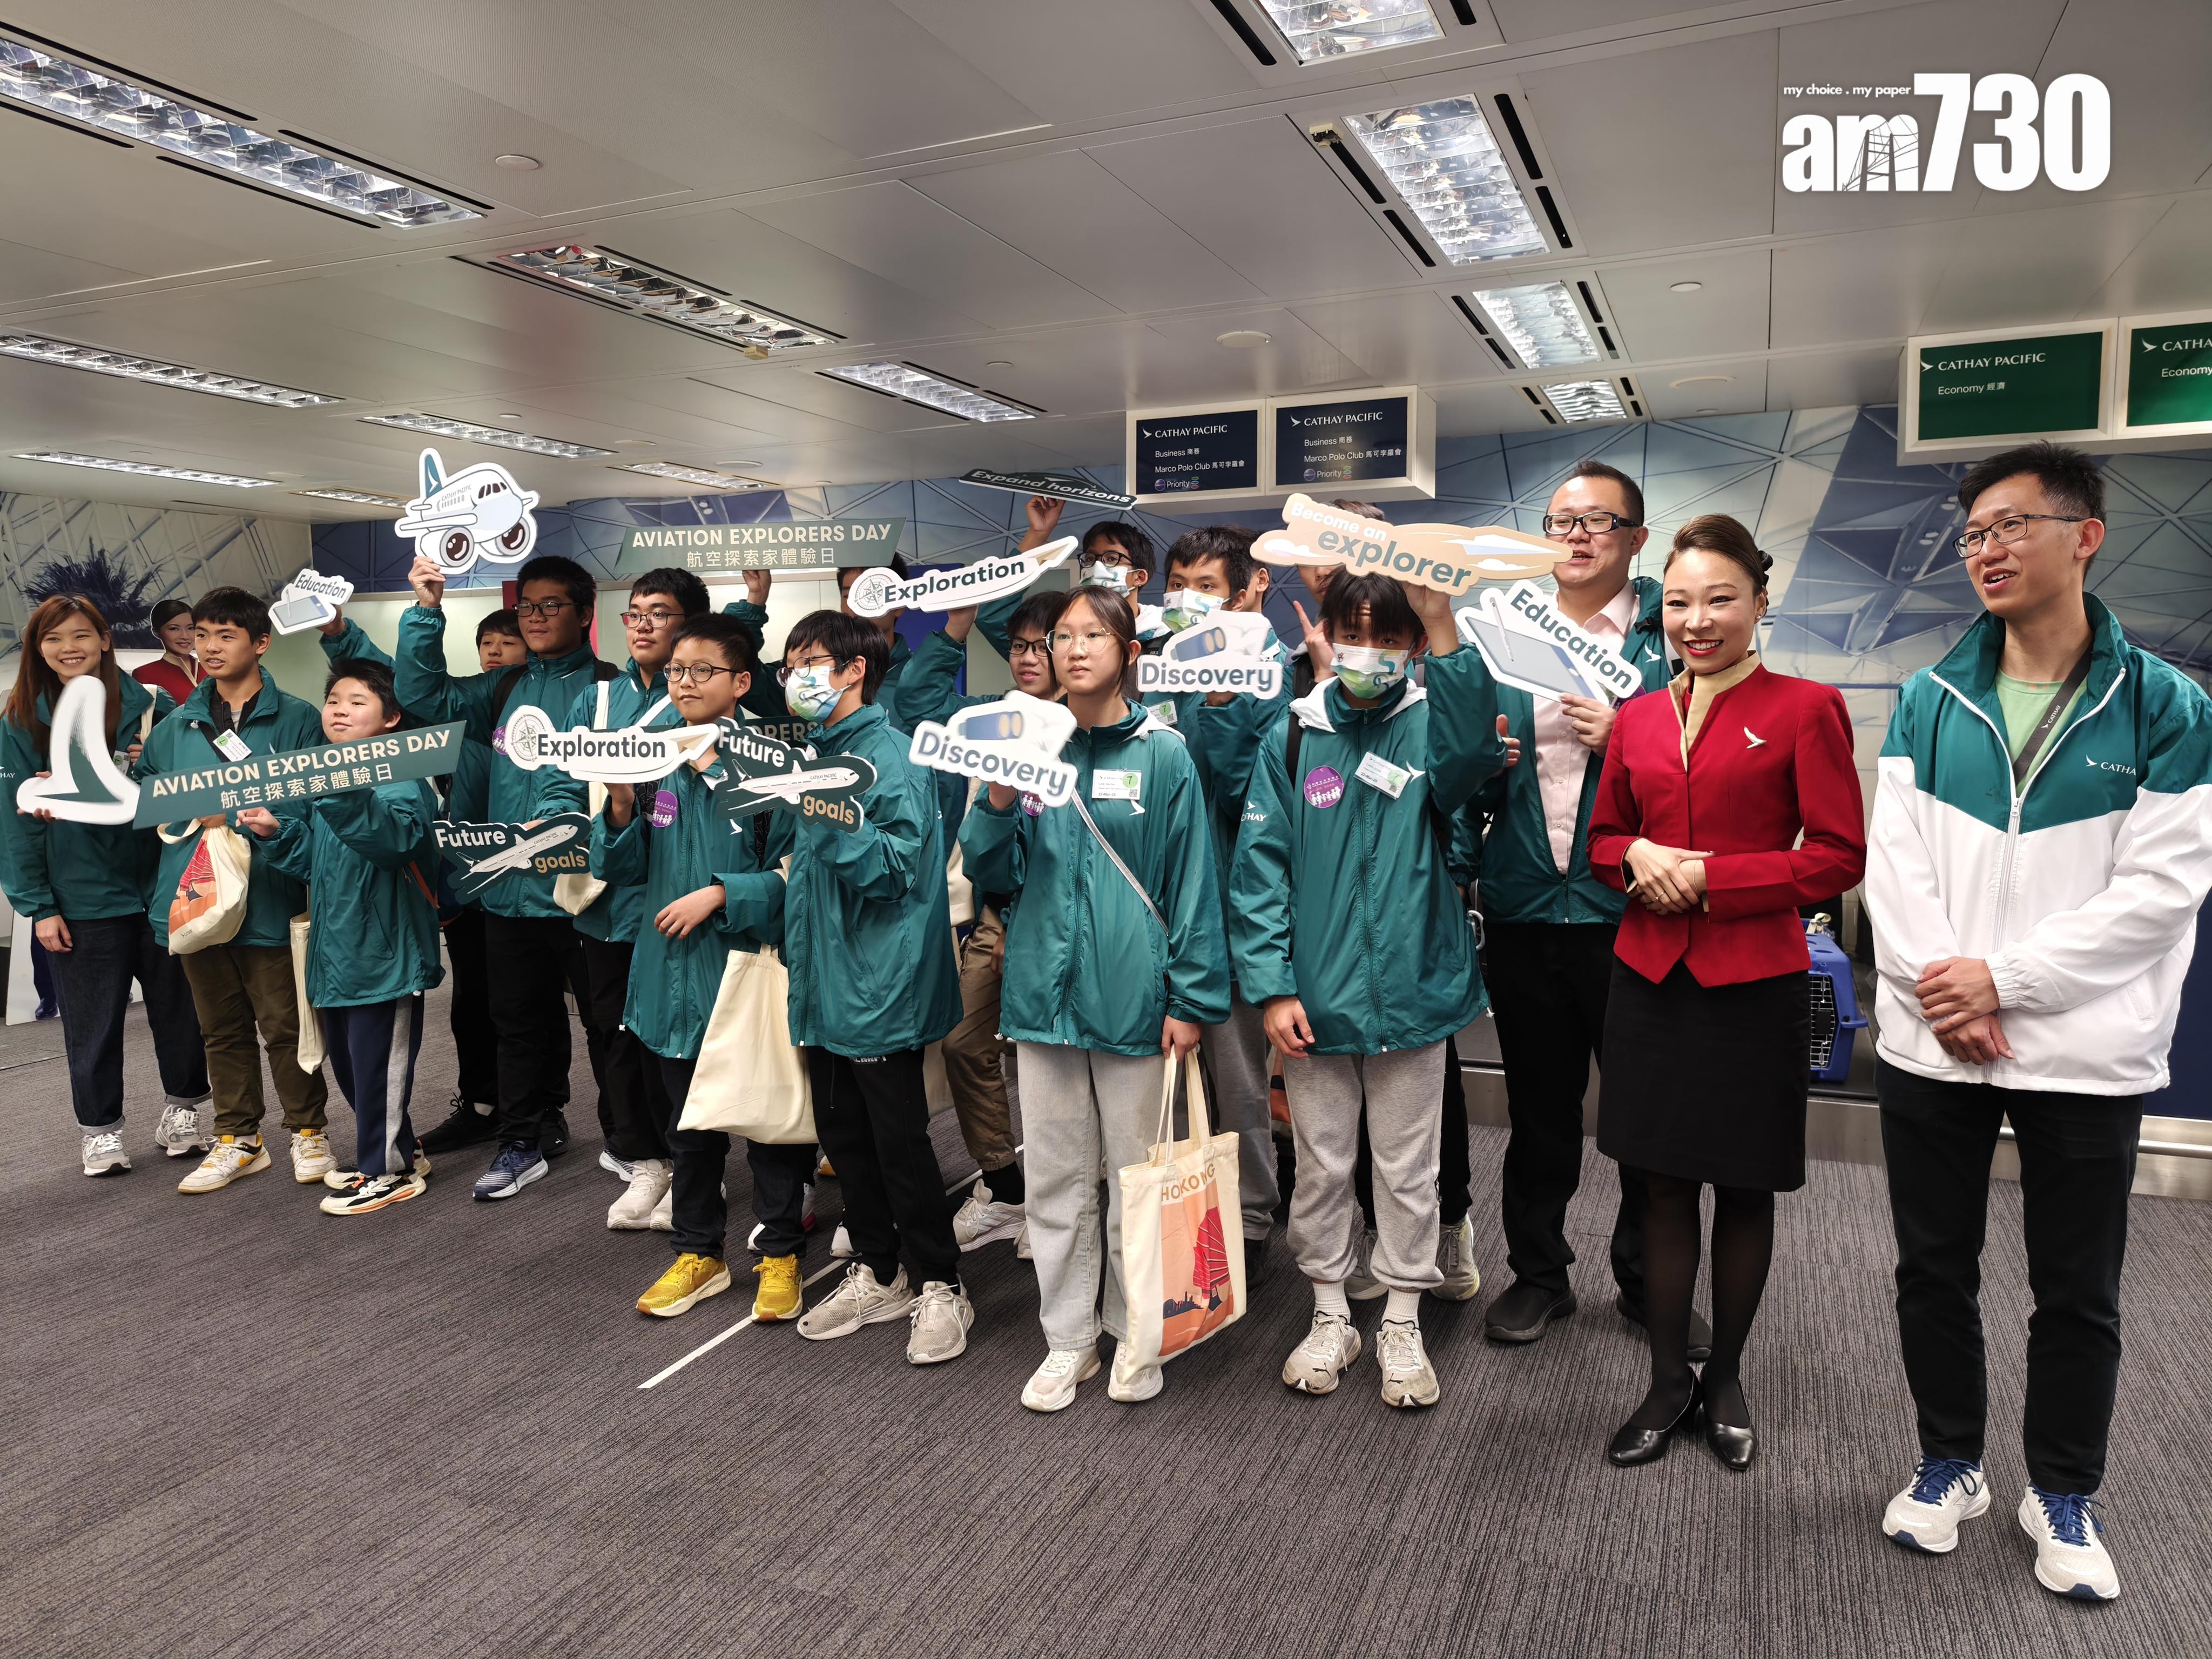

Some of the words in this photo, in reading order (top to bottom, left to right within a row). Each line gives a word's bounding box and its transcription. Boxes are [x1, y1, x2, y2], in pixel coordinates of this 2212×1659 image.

[1938, 357, 1992, 371] CATHAY
[1994, 353, 2046, 366] PACIFIC
[1938, 384, 1984, 395] Economy
[1987, 381, 2006, 390] 經濟
[1304, 415, 1344, 426] CATHAY
[1346, 412, 1383, 423] PACIFIC
[1155, 428, 1191, 439] CATHAY
[1193, 425, 1228, 435] PACIFIC
[1304, 438, 1337, 446] Business
[1339, 436, 1353, 444] 商務
[1155, 449, 1185, 457] Business
[1195, 462, 1210, 470] Club
[1317, 469, 1341, 478] Priority
[441, 491, 457, 502] CATHAY
[457, 484, 471, 495] PACIFIC
[971, 470, 1045, 487] Expand
[1047, 482, 1131, 503] horizons
[1166, 480, 1189, 488] Priority
[1291, 503, 1360, 534] Become
[1363, 526, 1387, 542] an
[632, 529, 723, 548] AVIATION
[730, 525, 845, 545] EXPLORERS
[851, 524, 892, 541] DAY
[687, 547, 835, 568] 航空探索家體驗日
[1318, 530, 1472, 588] explorer
[295, 574, 347, 599] Education
[885, 558, 1024, 603] Exploration
[1510, 588, 1631, 690] Education
[1142, 662, 1273, 692] Discovery
[538, 734, 665, 762] Exploration
[719, 725, 785, 767] Future
[152, 762, 260, 798] AVIATION
[269, 738, 400, 778] EXPLORERS
[408, 730, 451, 753] DAY
[917, 730, 1067, 796] Discovery
[220, 763, 393, 810] 航空探索家體驗日
[1126, 775, 1132, 785] 7
[803, 795, 854, 825] goals
[435, 828, 506, 848] Future
[535, 851, 586, 874] goals
